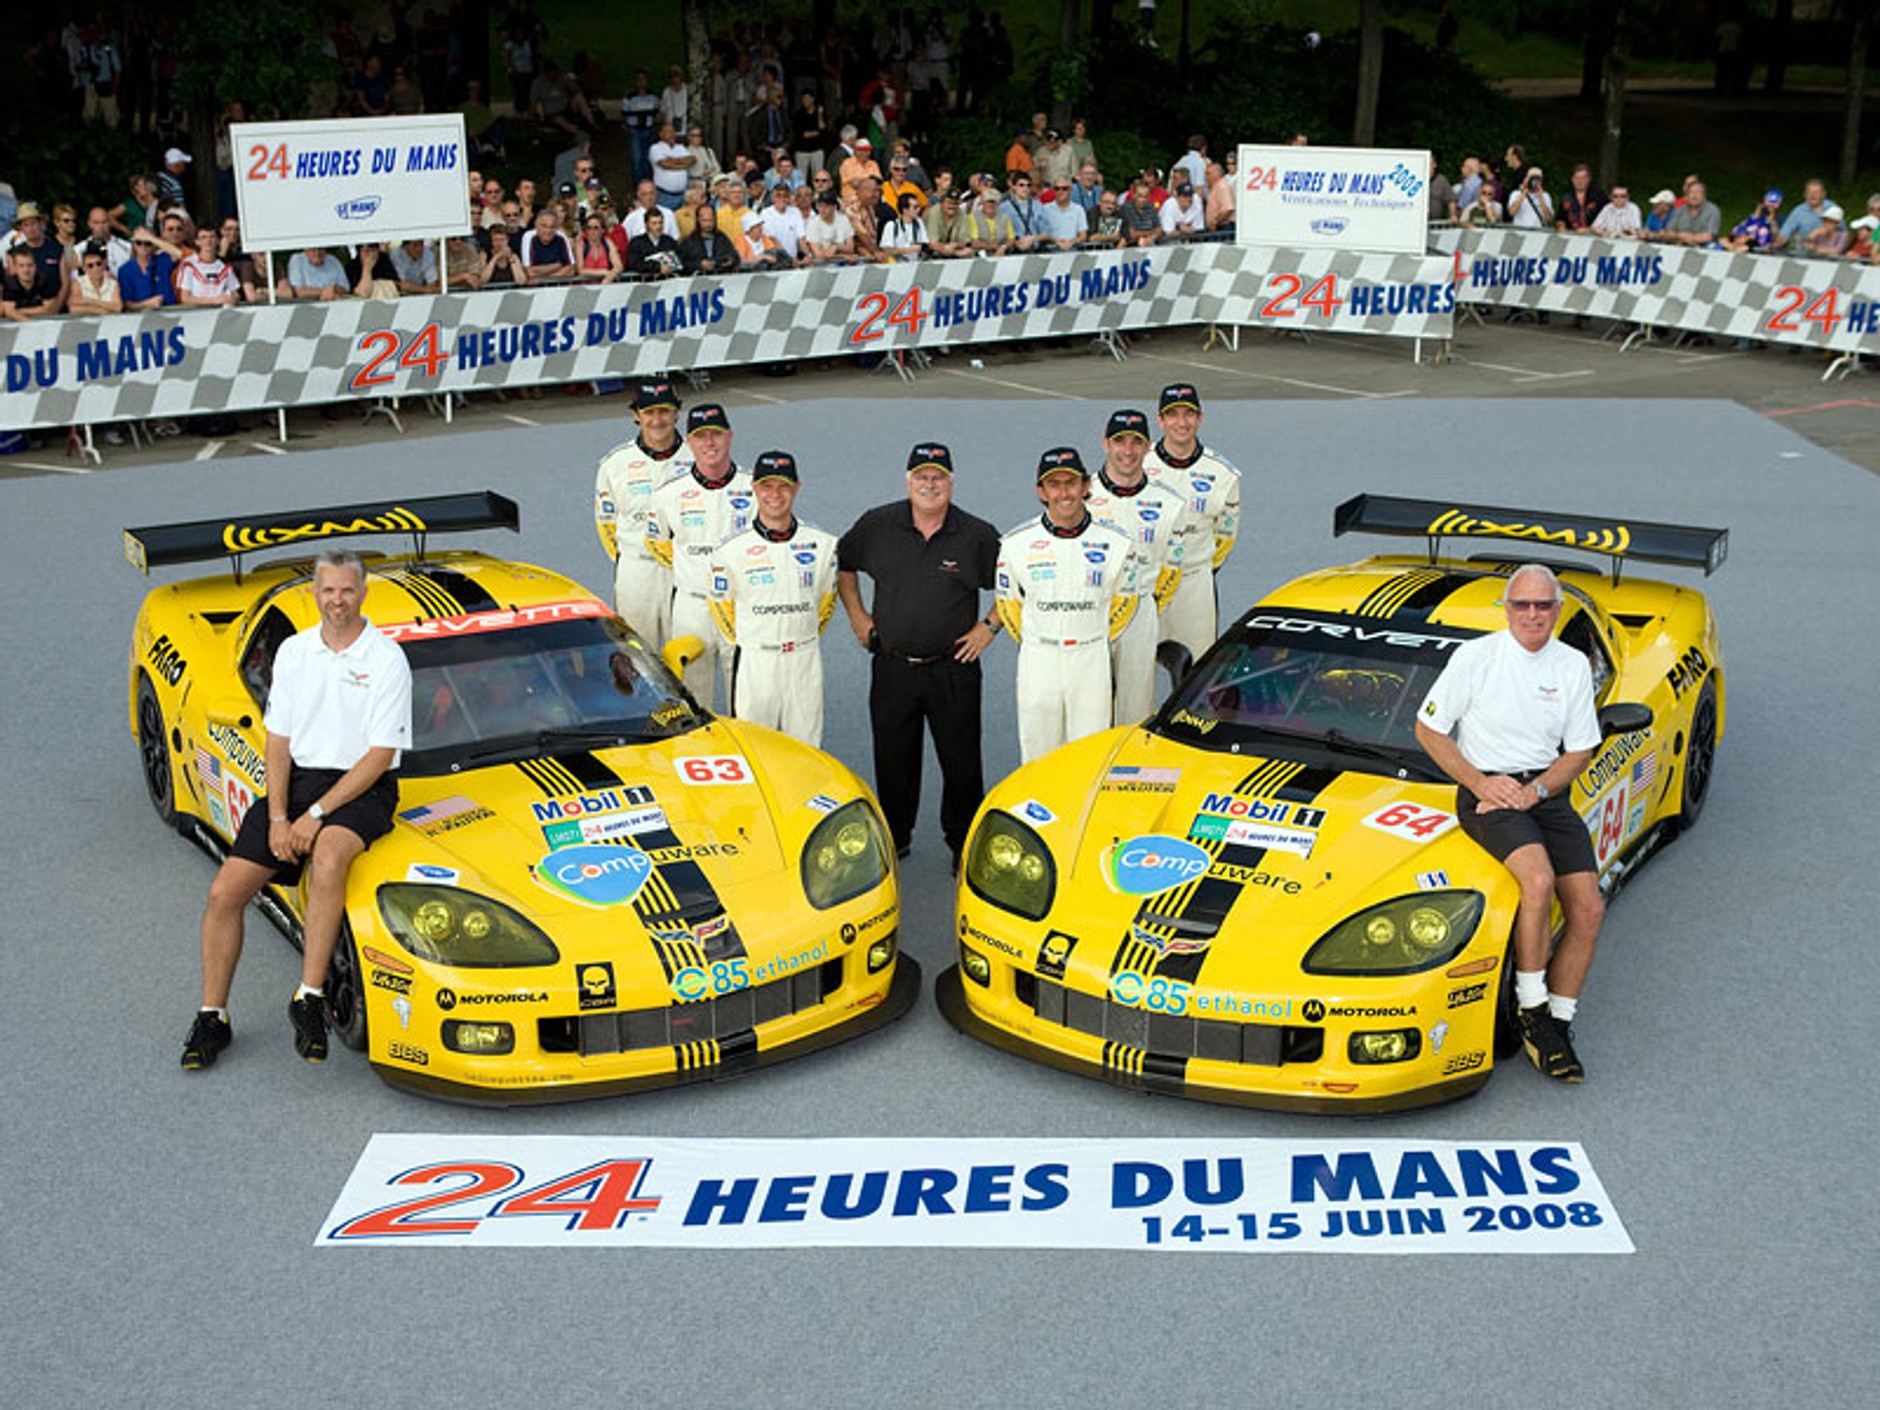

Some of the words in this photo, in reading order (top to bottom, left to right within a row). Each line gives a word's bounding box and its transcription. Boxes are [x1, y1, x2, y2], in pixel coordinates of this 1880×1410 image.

[247, 143, 292, 180] 24
[296, 149, 361, 180] HEURES
[371, 147, 396, 175] DU
[405, 142, 458, 173] MANS
[1247, 166, 1277, 190] 24
[1281, 171, 1326, 193] HEURES
[1328, 172, 1348, 194] DU
[1348, 173, 1386, 195] MANS
[1388, 163, 1423, 198] 2008
[1471, 256, 1549, 288] HEURES
[1553, 256, 1588, 284] DU
[1595, 256, 1663, 285] MANS
[849, 286, 928, 344] 24
[933, 282, 1029, 328] HEURES
[1036, 274, 1071, 308] DU
[1079, 259, 1151, 301] MANS
[1259, 272, 1343, 318] 24
[1349, 281, 1456, 316] HEURES
[1766, 286, 1842, 335] 24
[348, 320, 450, 392] 24
[457, 315, 575, 370] HEURES
[585, 306, 628, 347] DU
[639, 288, 725, 338] MANS
[6, 347, 58, 393] DU
[77, 325, 185, 382] MANS
[378, 603, 603, 639] ORVETTE
[1246, 615, 1464, 650] CORVET
[148, 634, 187, 687] FARO
[683, 758, 745, 782] 63
[531, 790, 622, 821] Mobil
[1200, 793, 1290, 823] Mobil
[1375, 803, 1451, 838] 64
[1598, 788, 1625, 861] 64
[755, 941, 829, 980] ethanol
[968, 927, 1023, 959] MOTOROLA
[459, 991, 550, 1005] MOTOROLA
[1197, 996, 1292, 1019] ethanol
[1328, 1006, 1417, 1017] MOTOROLA
[326, 1157, 663, 1240] 24
[682, 1162, 1069, 1227] HEURES
[1111, 1156, 1245, 1209] DU
[1290, 1147, 1581, 1204] MANS
[1142, 1210, 1303, 1244] 14-15
[1320, 1207, 1446, 1239] JUIN
[1463, 1202, 1603, 1233] 2008
